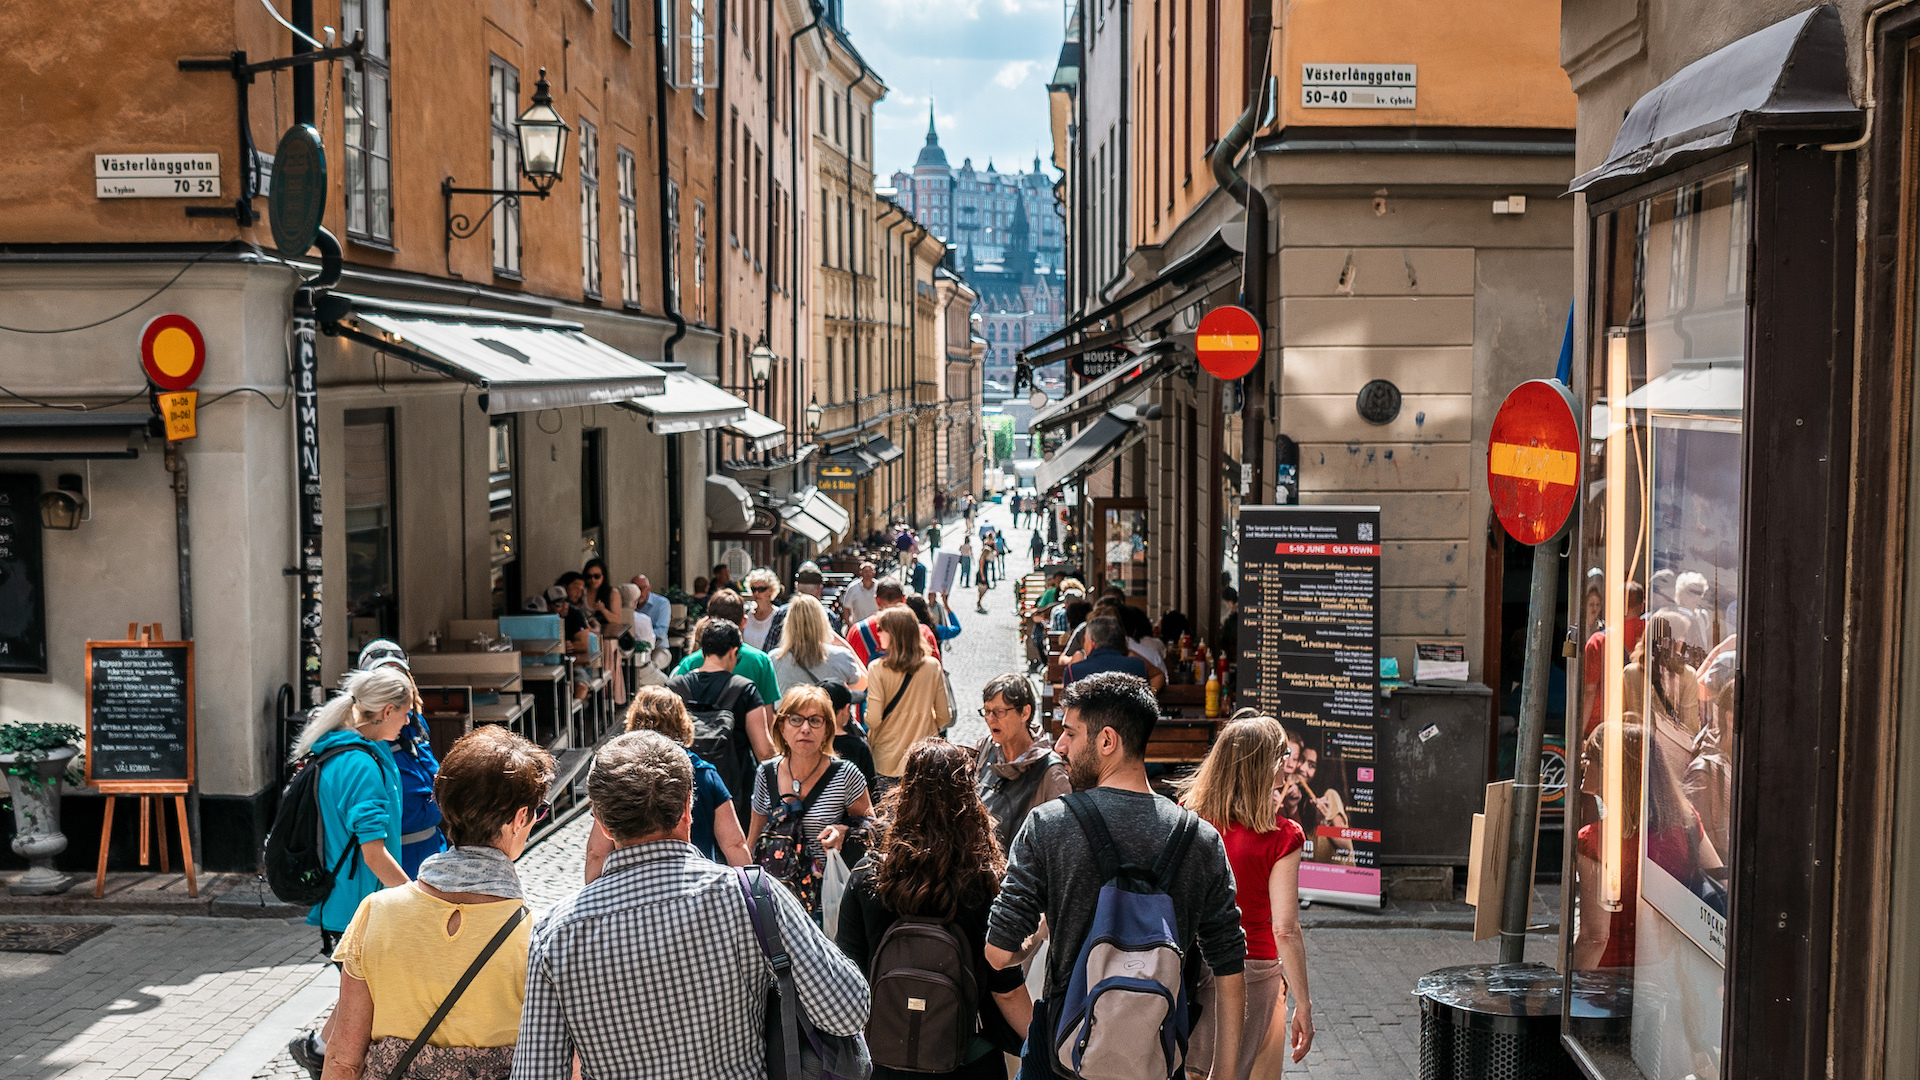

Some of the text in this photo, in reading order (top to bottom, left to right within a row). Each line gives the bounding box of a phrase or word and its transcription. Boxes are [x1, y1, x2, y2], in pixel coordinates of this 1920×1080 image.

[1305, 66, 1411, 85] Västerlånggatan
[1305, 90, 1348, 104] 50-40
[101, 157, 212, 175] Västerlånggatan
[1083, 350, 1117, 363] HOUSE
[1289, 544, 1373, 554] 5-10 JUNE OLD TOWN
[1284, 561, 1302, 570] Prague
[1340, 828, 1374, 840] SEMF.SE
[1700, 906, 1726, 937] STOCKH
